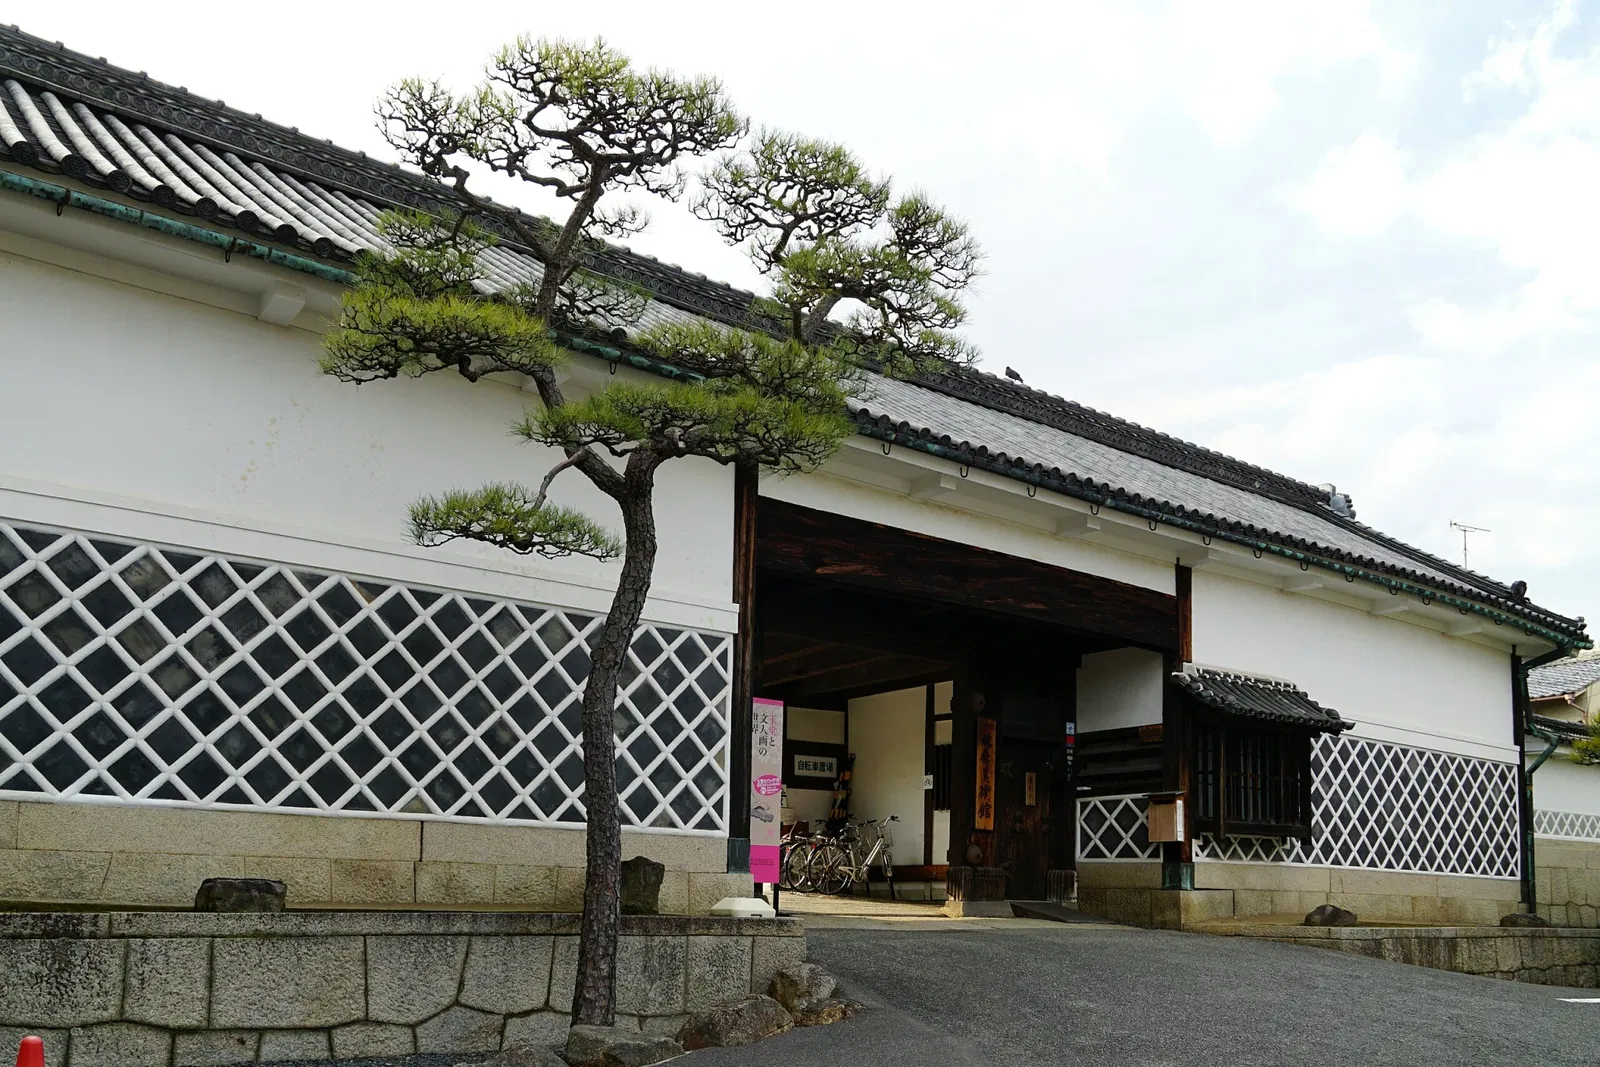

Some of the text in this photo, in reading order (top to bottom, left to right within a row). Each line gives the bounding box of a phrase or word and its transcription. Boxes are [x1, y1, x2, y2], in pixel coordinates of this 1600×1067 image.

[758, 713, 768, 757] 文人画の
[797, 760, 834, 773] 自転車置場
